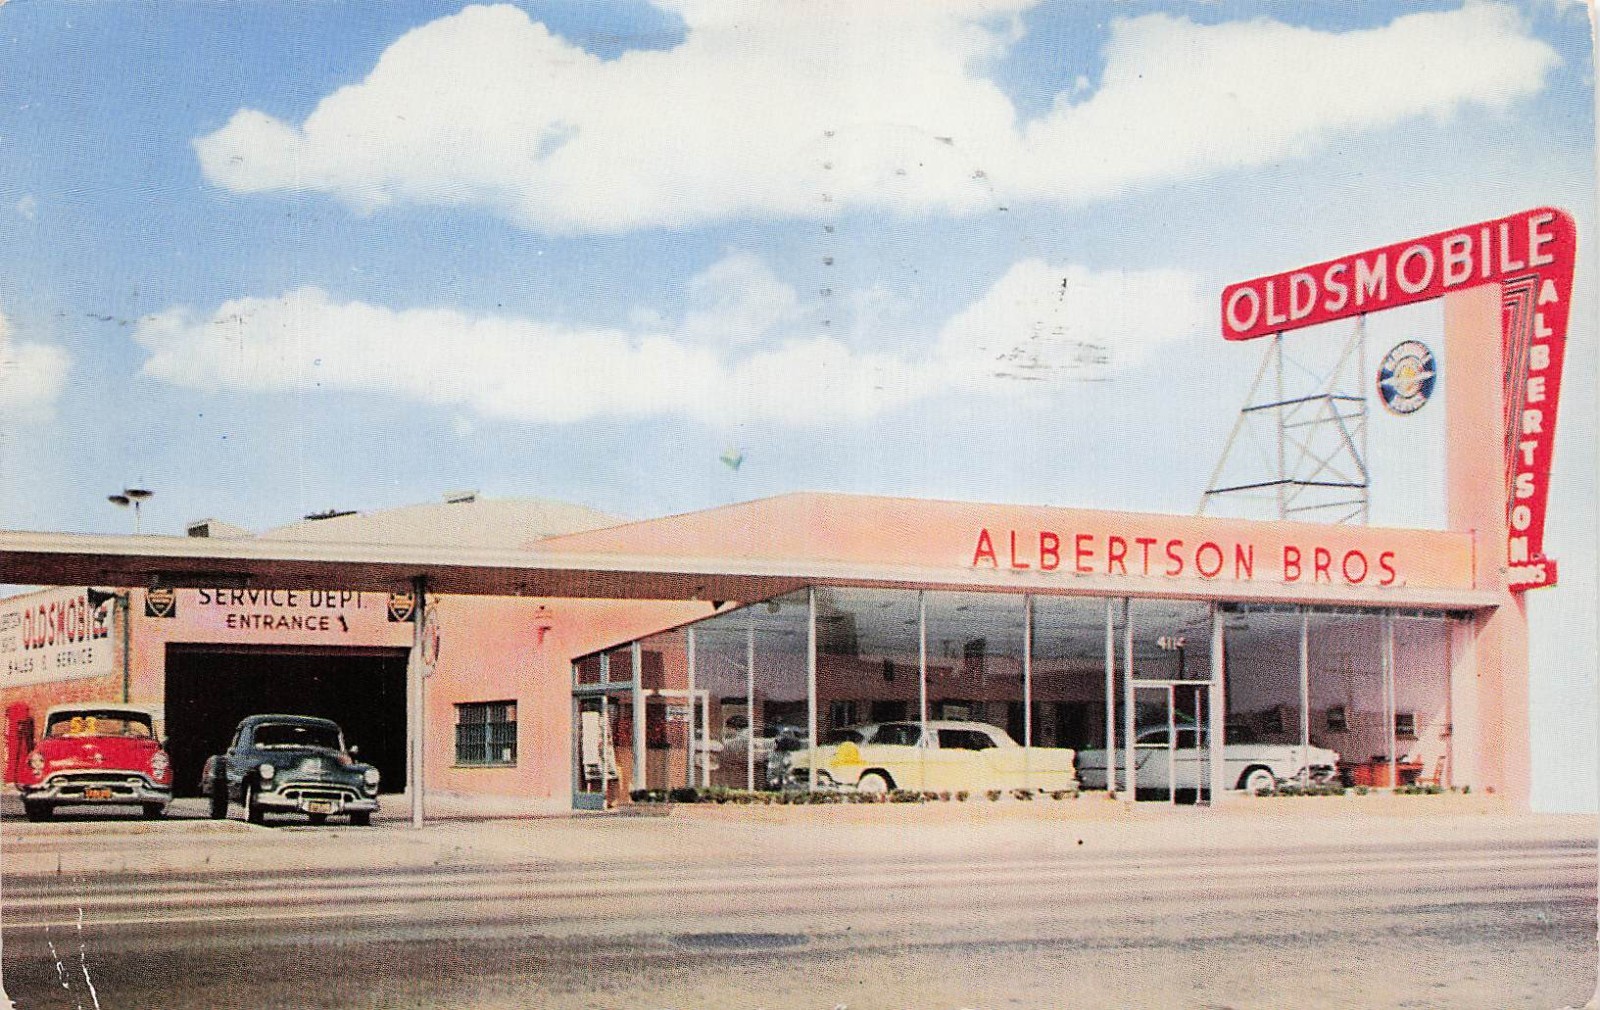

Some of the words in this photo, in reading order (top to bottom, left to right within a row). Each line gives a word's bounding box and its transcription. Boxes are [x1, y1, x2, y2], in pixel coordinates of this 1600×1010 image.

[1225, 211, 1558, 333] OLDSMOBILE
[1508, 278, 1560, 563] ALBERTSON
[972, 527, 1254, 581] ALBERTSON
[198, 588, 299, 608] SERVICE
[225, 613, 330, 631] ENTRANCE
